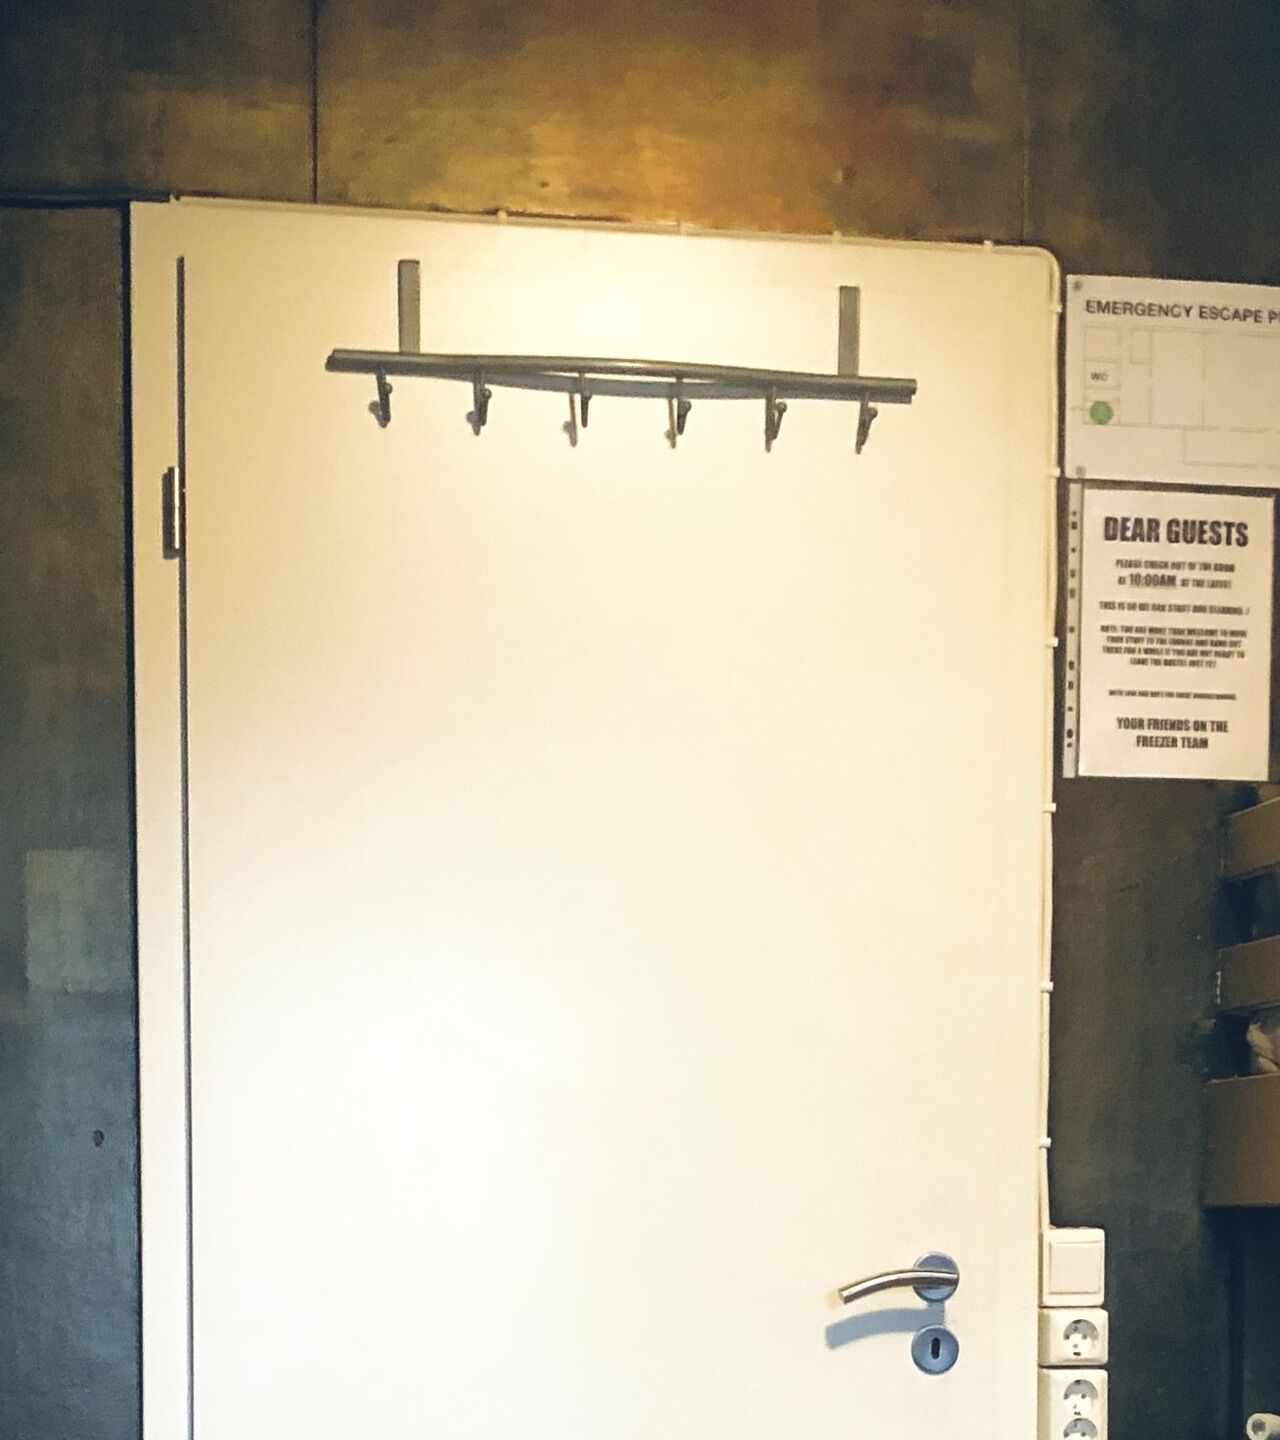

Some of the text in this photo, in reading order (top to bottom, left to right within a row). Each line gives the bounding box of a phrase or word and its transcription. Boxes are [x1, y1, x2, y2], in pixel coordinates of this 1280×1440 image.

[1085, 299, 1192, 318] EMERGENCY
[1199, 305, 1262, 323] ESCAPE
[1090, 371, 1108, 381] WC
[1104, 516, 1249, 547] DEAR GUESTS
[1130, 573, 1176, 587] 10:00AM
[1116, 716, 1228, 733] YOUR FRIENDS ON THE
[1136, 735, 1208, 750] FREEZER TEAM
